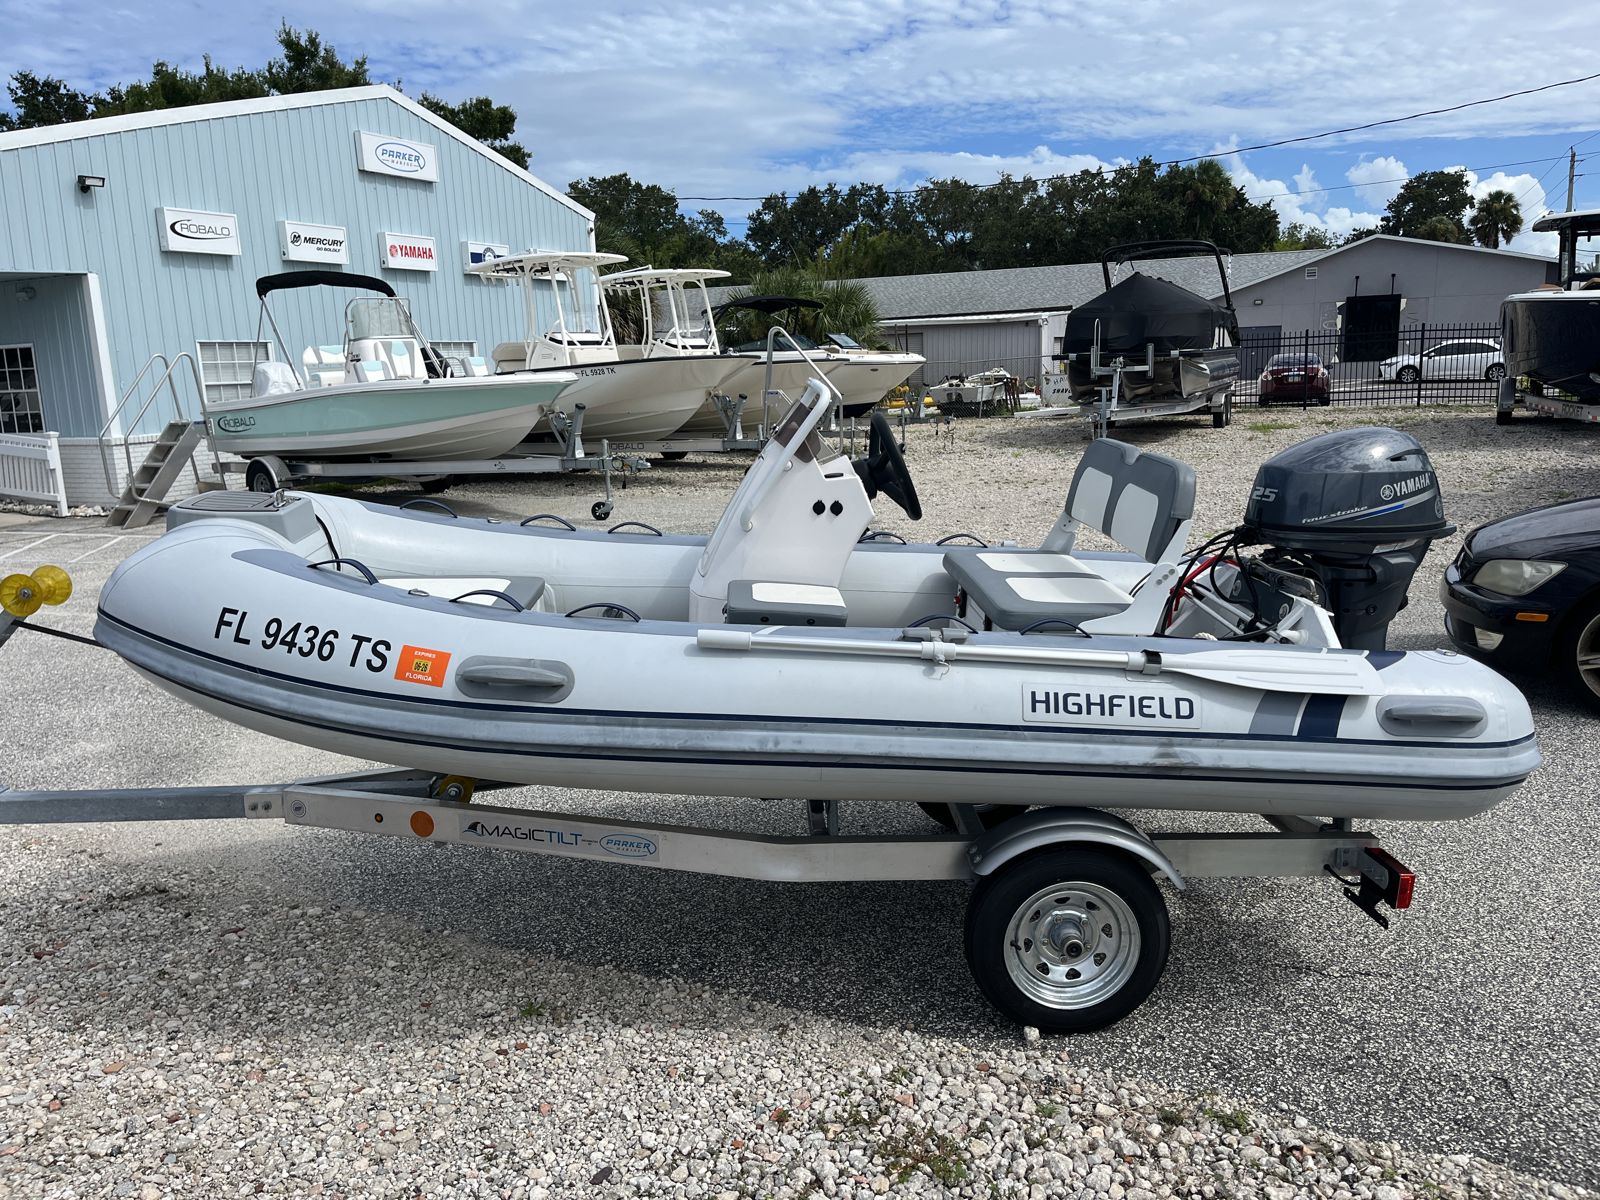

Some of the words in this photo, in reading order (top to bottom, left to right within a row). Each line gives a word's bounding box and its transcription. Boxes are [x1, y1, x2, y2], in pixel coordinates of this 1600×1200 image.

[381, 148, 421, 163] PARKER
[180, 223, 231, 236] ROBALO
[303, 236, 344, 247] MERCURY
[398, 244, 434, 260] YAMAHA
[590, 368, 606, 376] 5928
[223, 416, 256, 428] ROBALO
[1394, 473, 1431, 497] YAMAHA
[1252, 486, 1278, 502] 25
[214, 606, 250, 645] FL
[262, 618, 339, 662] 9436
[350, 634, 392, 672] TS
[405, 672, 432, 682] FLORIDA
[1030, 690, 1194, 720] HIGHFIELD
[481, 824, 582, 846] MAGICTILT
[606, 838, 651, 850] PARKER
